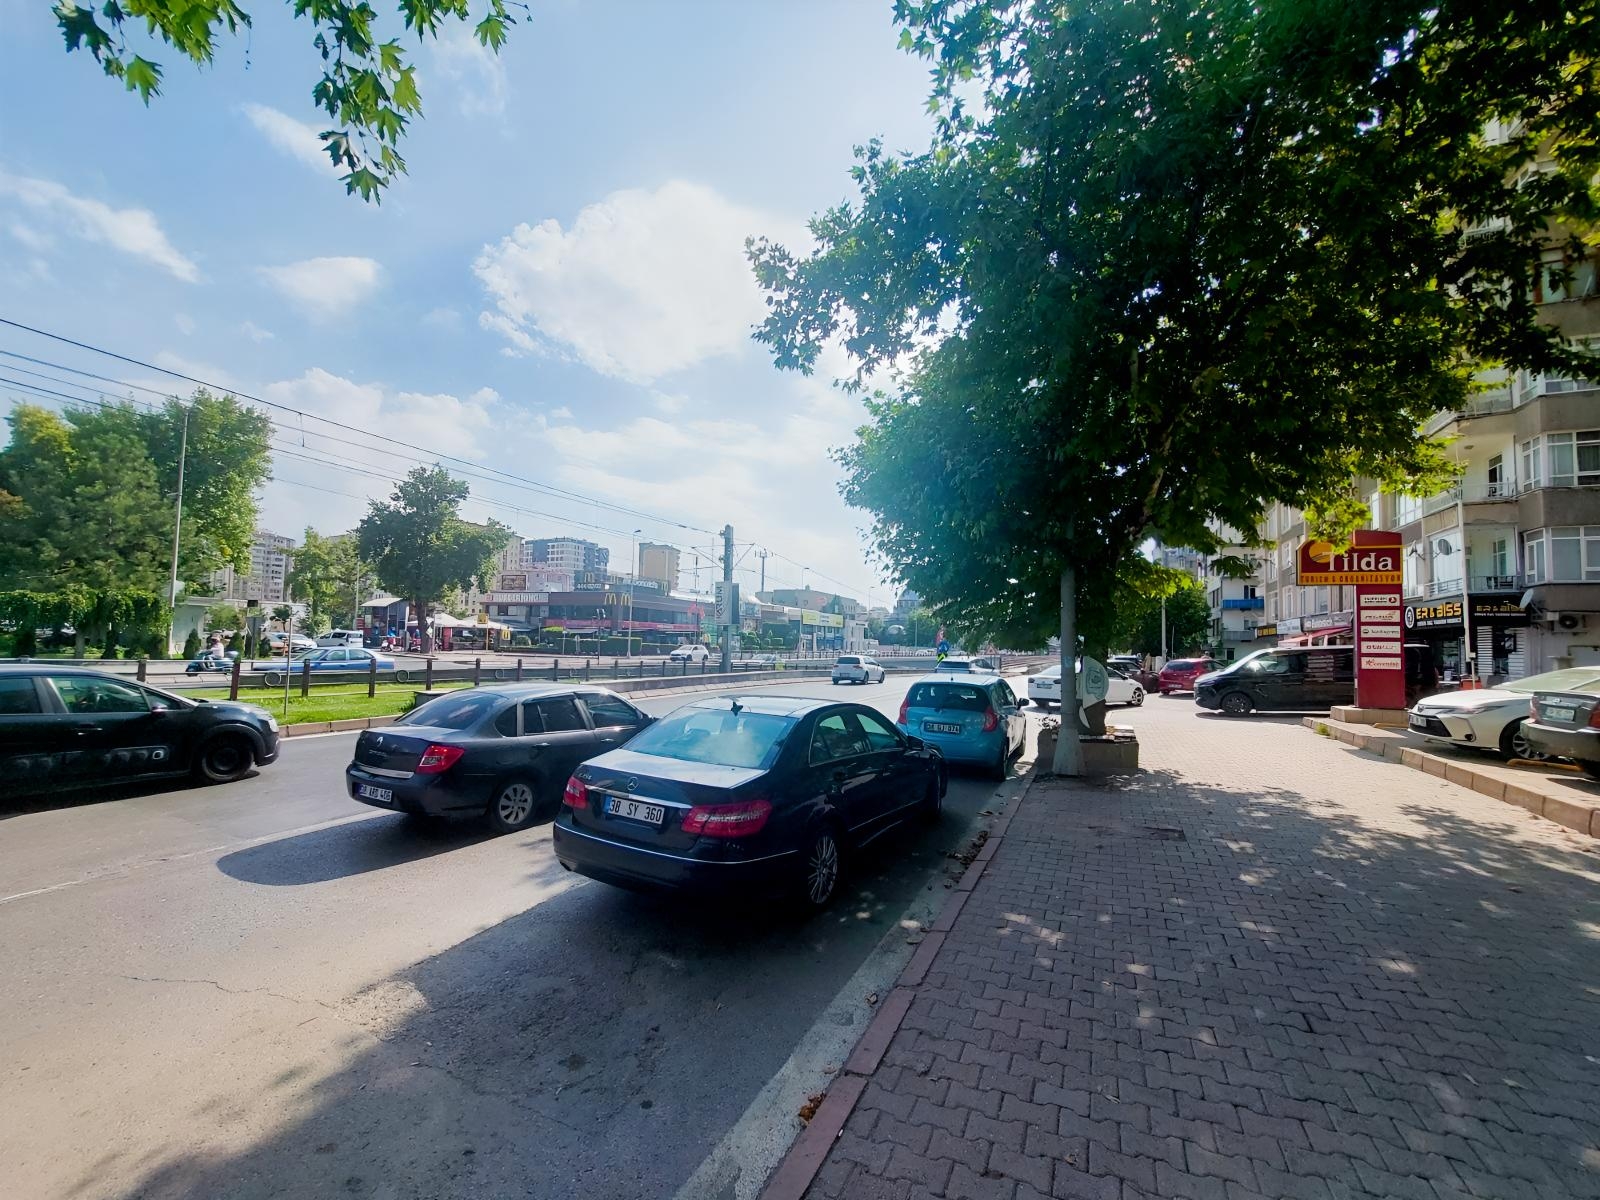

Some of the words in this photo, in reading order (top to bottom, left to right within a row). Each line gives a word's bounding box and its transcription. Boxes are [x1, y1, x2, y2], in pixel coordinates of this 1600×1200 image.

[1321, 551, 1394, 572] Tilda
[609, 800, 621, 813] 38
[627, 804, 639, 817] SY
[644, 806, 663, 822] 360
